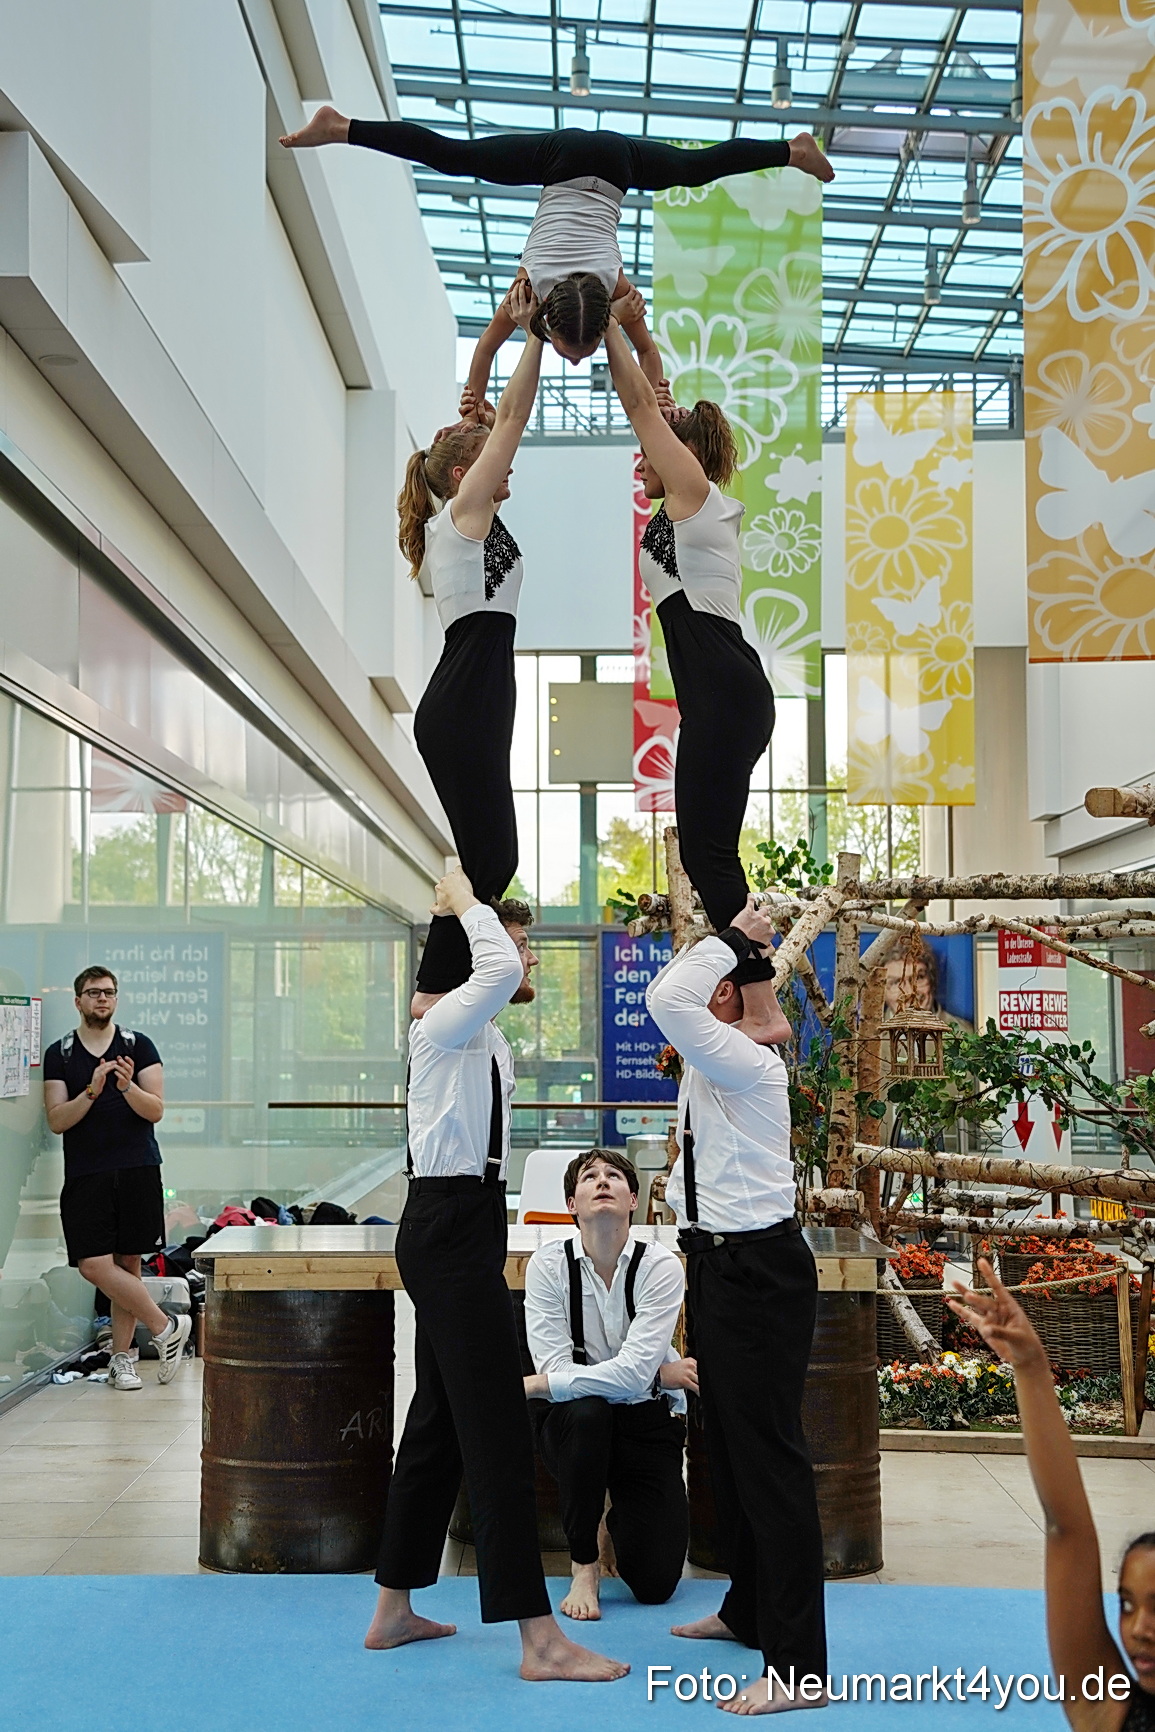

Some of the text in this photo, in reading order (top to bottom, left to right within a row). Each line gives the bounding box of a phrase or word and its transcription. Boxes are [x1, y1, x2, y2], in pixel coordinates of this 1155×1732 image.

[614, 943, 644, 962] Ich
[614, 964, 651, 983] den
[1000, 993, 1042, 1012] REWE
[1043, 994, 1067, 1012] REWE
[614, 1007, 648, 1026] der
[1000, 1013, 1042, 1027] CENTER
[1042, 1014, 1068, 1028] CENTER
[615, 1042, 632, 1052] Mit
[634, 1042, 656, 1052] HD+
[616, 1055, 658, 1066] Fernseh
